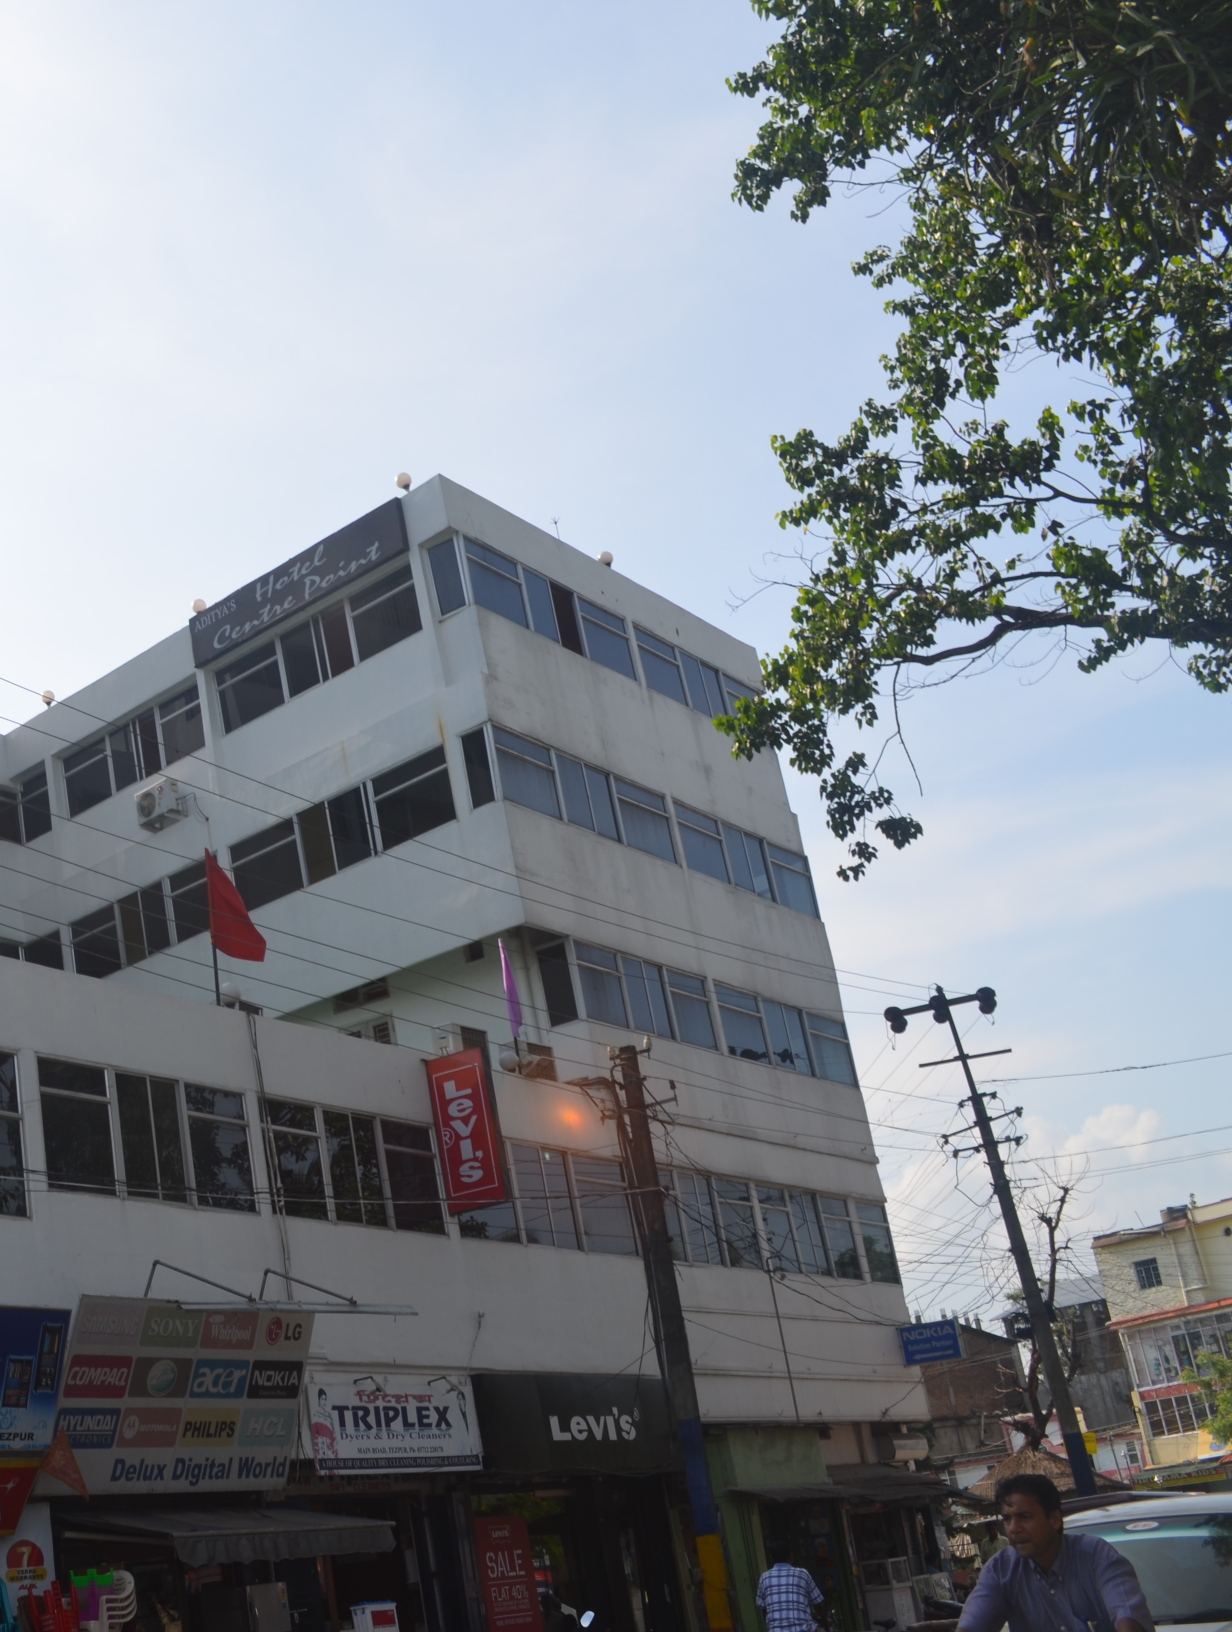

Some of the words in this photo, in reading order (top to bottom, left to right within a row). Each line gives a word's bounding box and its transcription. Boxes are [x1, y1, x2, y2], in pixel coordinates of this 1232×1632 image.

[256, 544, 326, 602] Hotel
[213, 596, 296, 649] Centre
[304, 542, 380, 600] Point
[194, 600, 236, 632] ADITYA'S
[80, 1316, 138, 1336] SAMSUNG
[148, 1317, 199, 1337] SONY
[211, 1324, 252, 1343] Whirlpool
[284, 1323, 302, 1341] LG
[902, 1325, 954, 1342] NOKIA
[932, 1339, 954, 1348] Partner
[67, 1367, 128, 1386] COMPAQ
[192, 1367, 246, 1393] acer
[252, 1370, 298, 1387] NOKIA
[58, 1415, 116, 1431] HYUNDAI
[139, 1424, 176, 1433] MOTOROLA
[182, 1421, 236, 1438] PHILIPS
[246, 1418, 288, 1437] HCL
[332, 1406, 452, 1431] TRIPLEX
[340, 1432, 370, 1442] Dyers
[374, 1432, 384, 1440] &
[387, 1432, 406, 1442] Dry
[409, 1430, 452, 1440] Cleaners
[110, 1458, 167, 1482] Delux
[172, 1457, 233, 1486] Digital
[237, 1456, 288, 1479] World
[326, 1460, 345, 1468] HOUSE
[354, 1459, 378, 1468] QUALITY
[378, 1458, 388, 1466] DRY
[389, 1458, 416, 1466] CLEANING
[416, 1457, 444, 1466] POLISHING
[1191, 1468, 1216, 1478] KIDS
[330, 1482, 346, 1492] DRY
[353, 1482, 390, 1492] CLEANERS
[16, 1546, 32, 1568] 7
[486, 1550, 526, 1578] SALE
[10, 1574, 44, 1582] WARRANTY
[491, 1586, 510, 1602] FLAT
[512, 1584, 528, 1599] 40%
